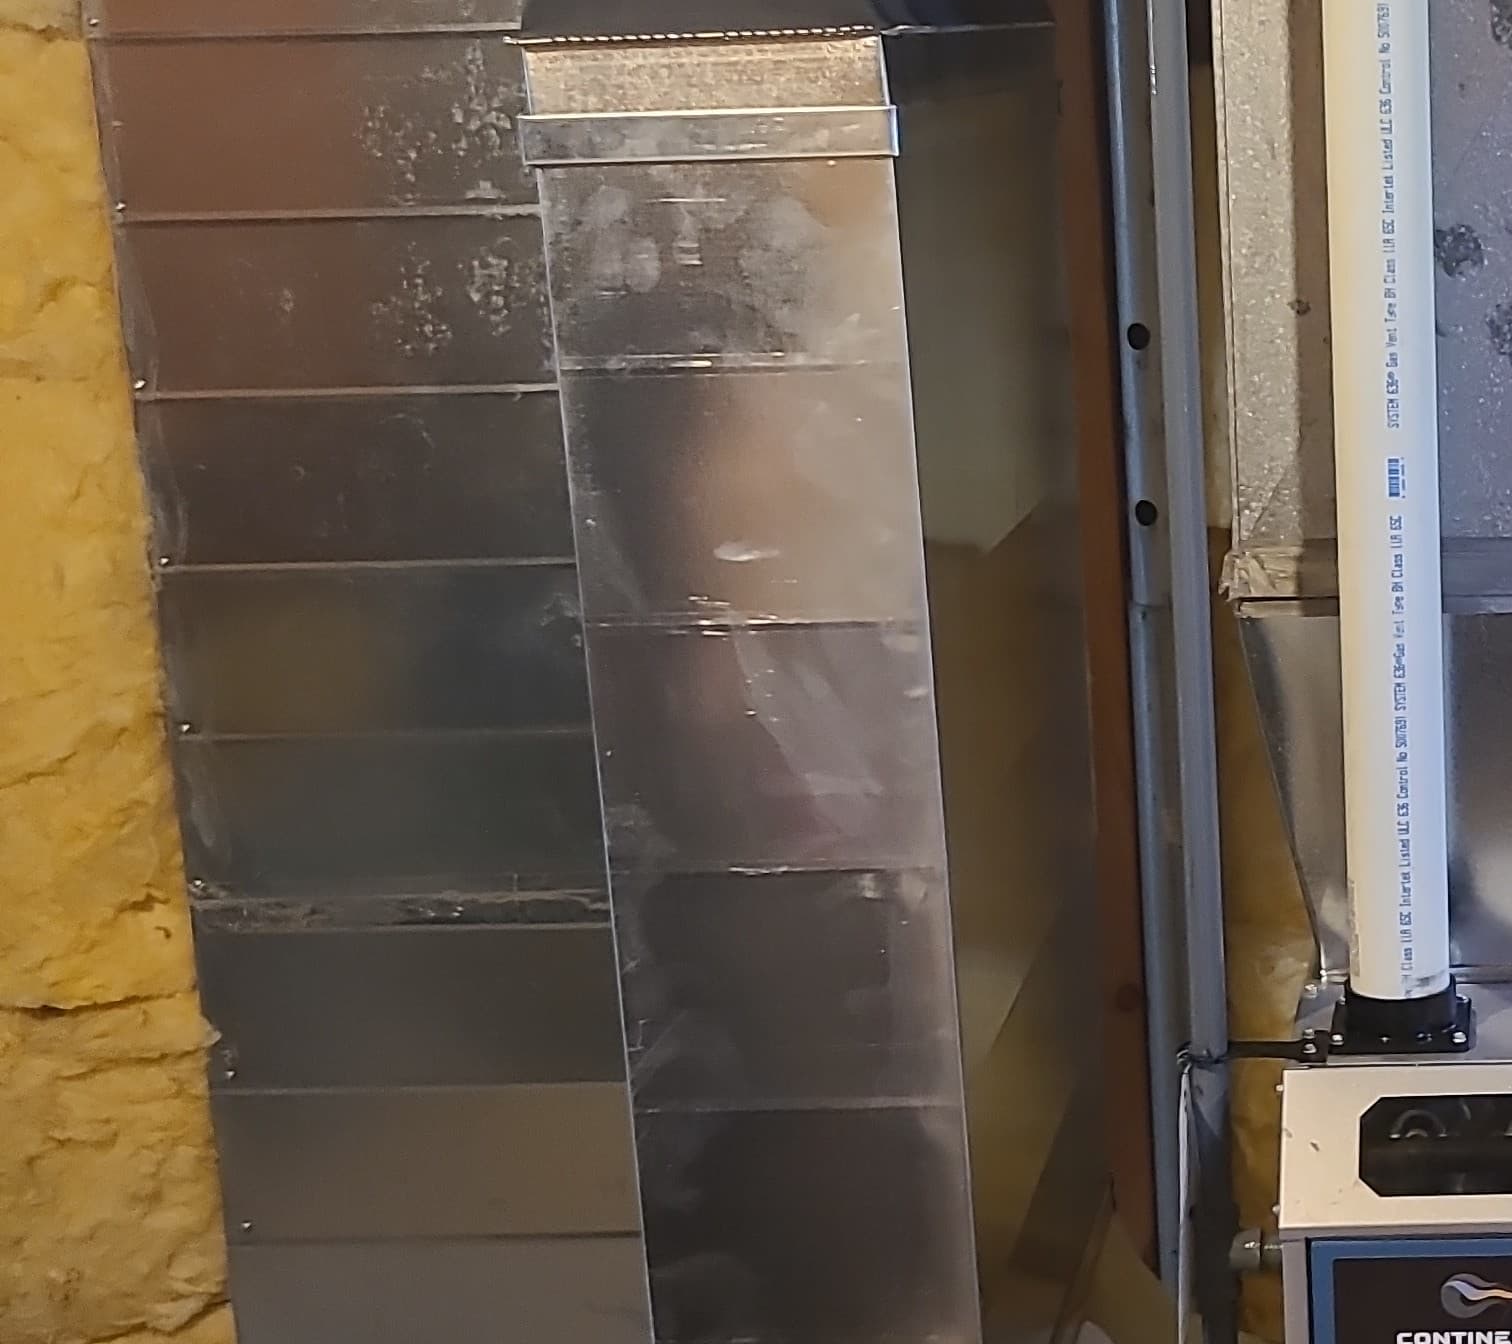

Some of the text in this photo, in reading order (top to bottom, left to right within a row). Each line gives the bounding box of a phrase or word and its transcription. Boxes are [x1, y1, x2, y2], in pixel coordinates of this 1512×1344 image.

[1377, 58, 1392, 95] Control
[1378, 97, 1392, 115] 636
[1379, 118, 1393, 135] ULC
[1379, 138, 1393, 171] Listed
[1382, 257, 1396, 285] Class
[1384, 302, 1399, 323] Type
[1384, 327, 1398, 348] Vent
[1385, 351, 1398, 368] Gas
[1386, 398, 1400, 429] SYSTEM
[1390, 553, 1404, 579] Class
[1391, 595, 1406, 616] Type
[1394, 682, 1407, 712] SYSTEM
[1396, 751, 1409, 763] No
[1396, 765, 1409, 800] Control
[1397, 802, 1409, 817] 636
[1397, 820, 1409, 836] ULC
[1397, 837, 1410, 868] Listed
[1398, 870, 1411, 907] Intertek
[1400, 947, 1413, 972] Class
